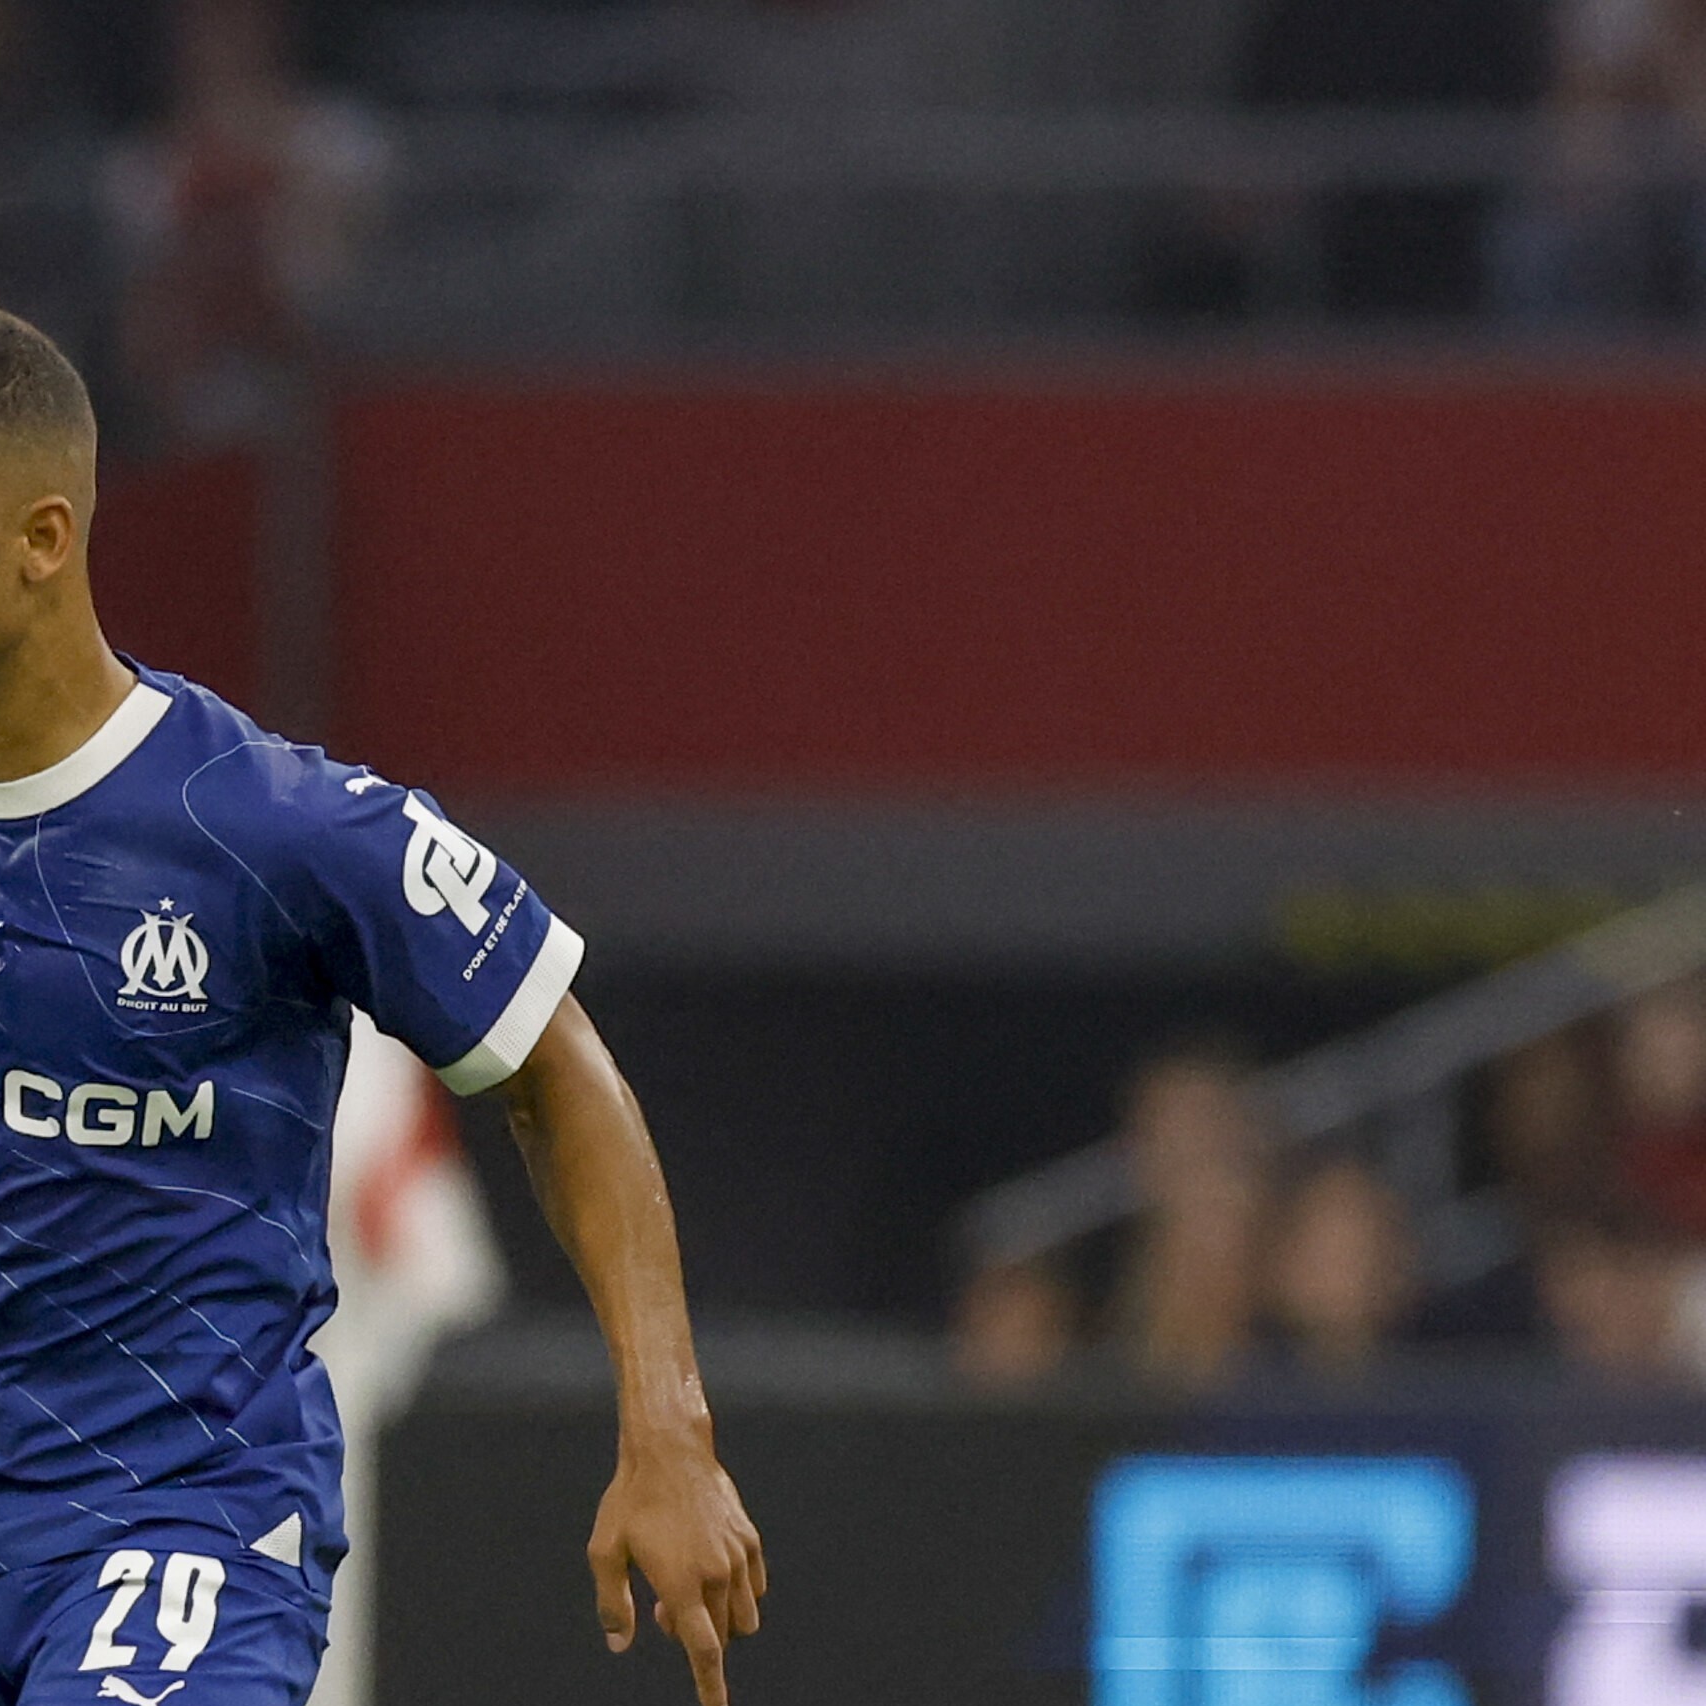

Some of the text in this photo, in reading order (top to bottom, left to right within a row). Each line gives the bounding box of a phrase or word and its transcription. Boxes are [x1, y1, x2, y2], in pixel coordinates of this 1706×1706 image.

[462, 948, 488, 982] D'OR
[483, 931, 499, 952] ET
[494, 912, 509, 936] DE
[116, 996, 208, 1014] DROIT AU BUT
[3, 1068, 215, 1148] CGM
[77, 1549, 227, 1673] 29
